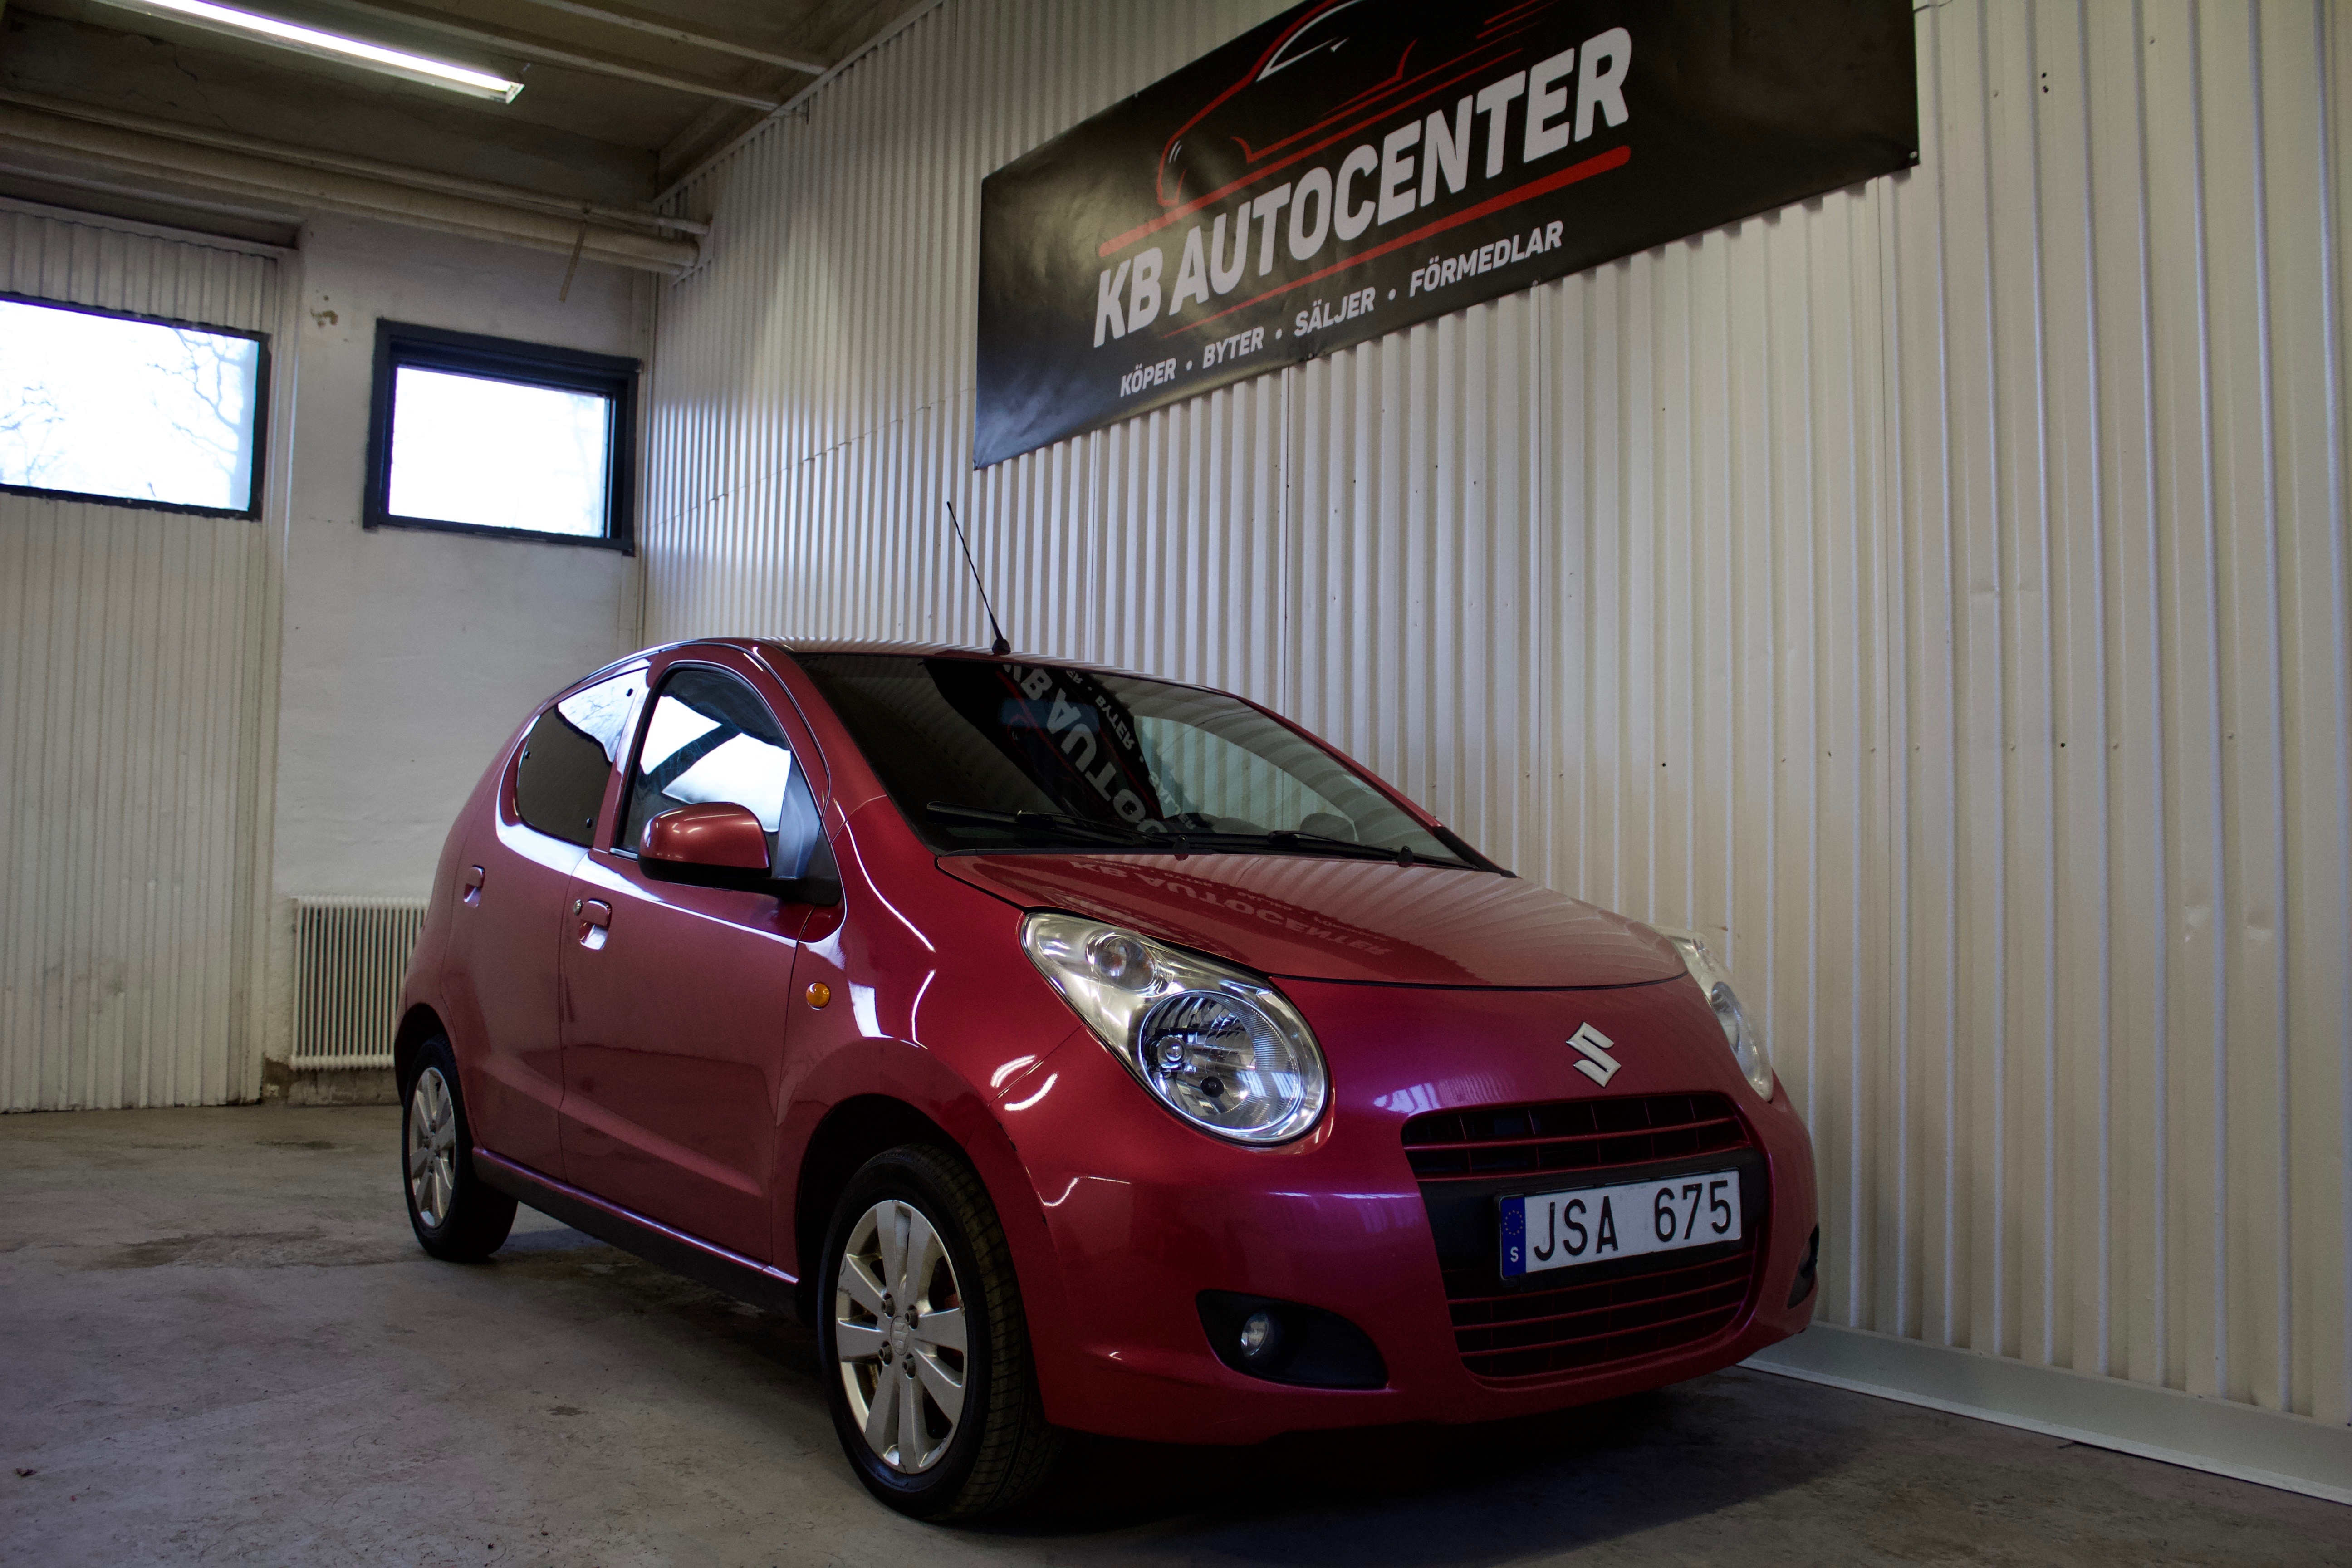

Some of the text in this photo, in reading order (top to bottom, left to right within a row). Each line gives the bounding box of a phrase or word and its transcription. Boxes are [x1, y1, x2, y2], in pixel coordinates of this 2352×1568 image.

[1093, 26, 1632, 348] KB AUTOCENTER
[1120, 220, 1563, 397] KÖPER BYTER SÄLJER FÖRMEDLAR
[1510, 1180, 1731, 1263] S JSA 675
